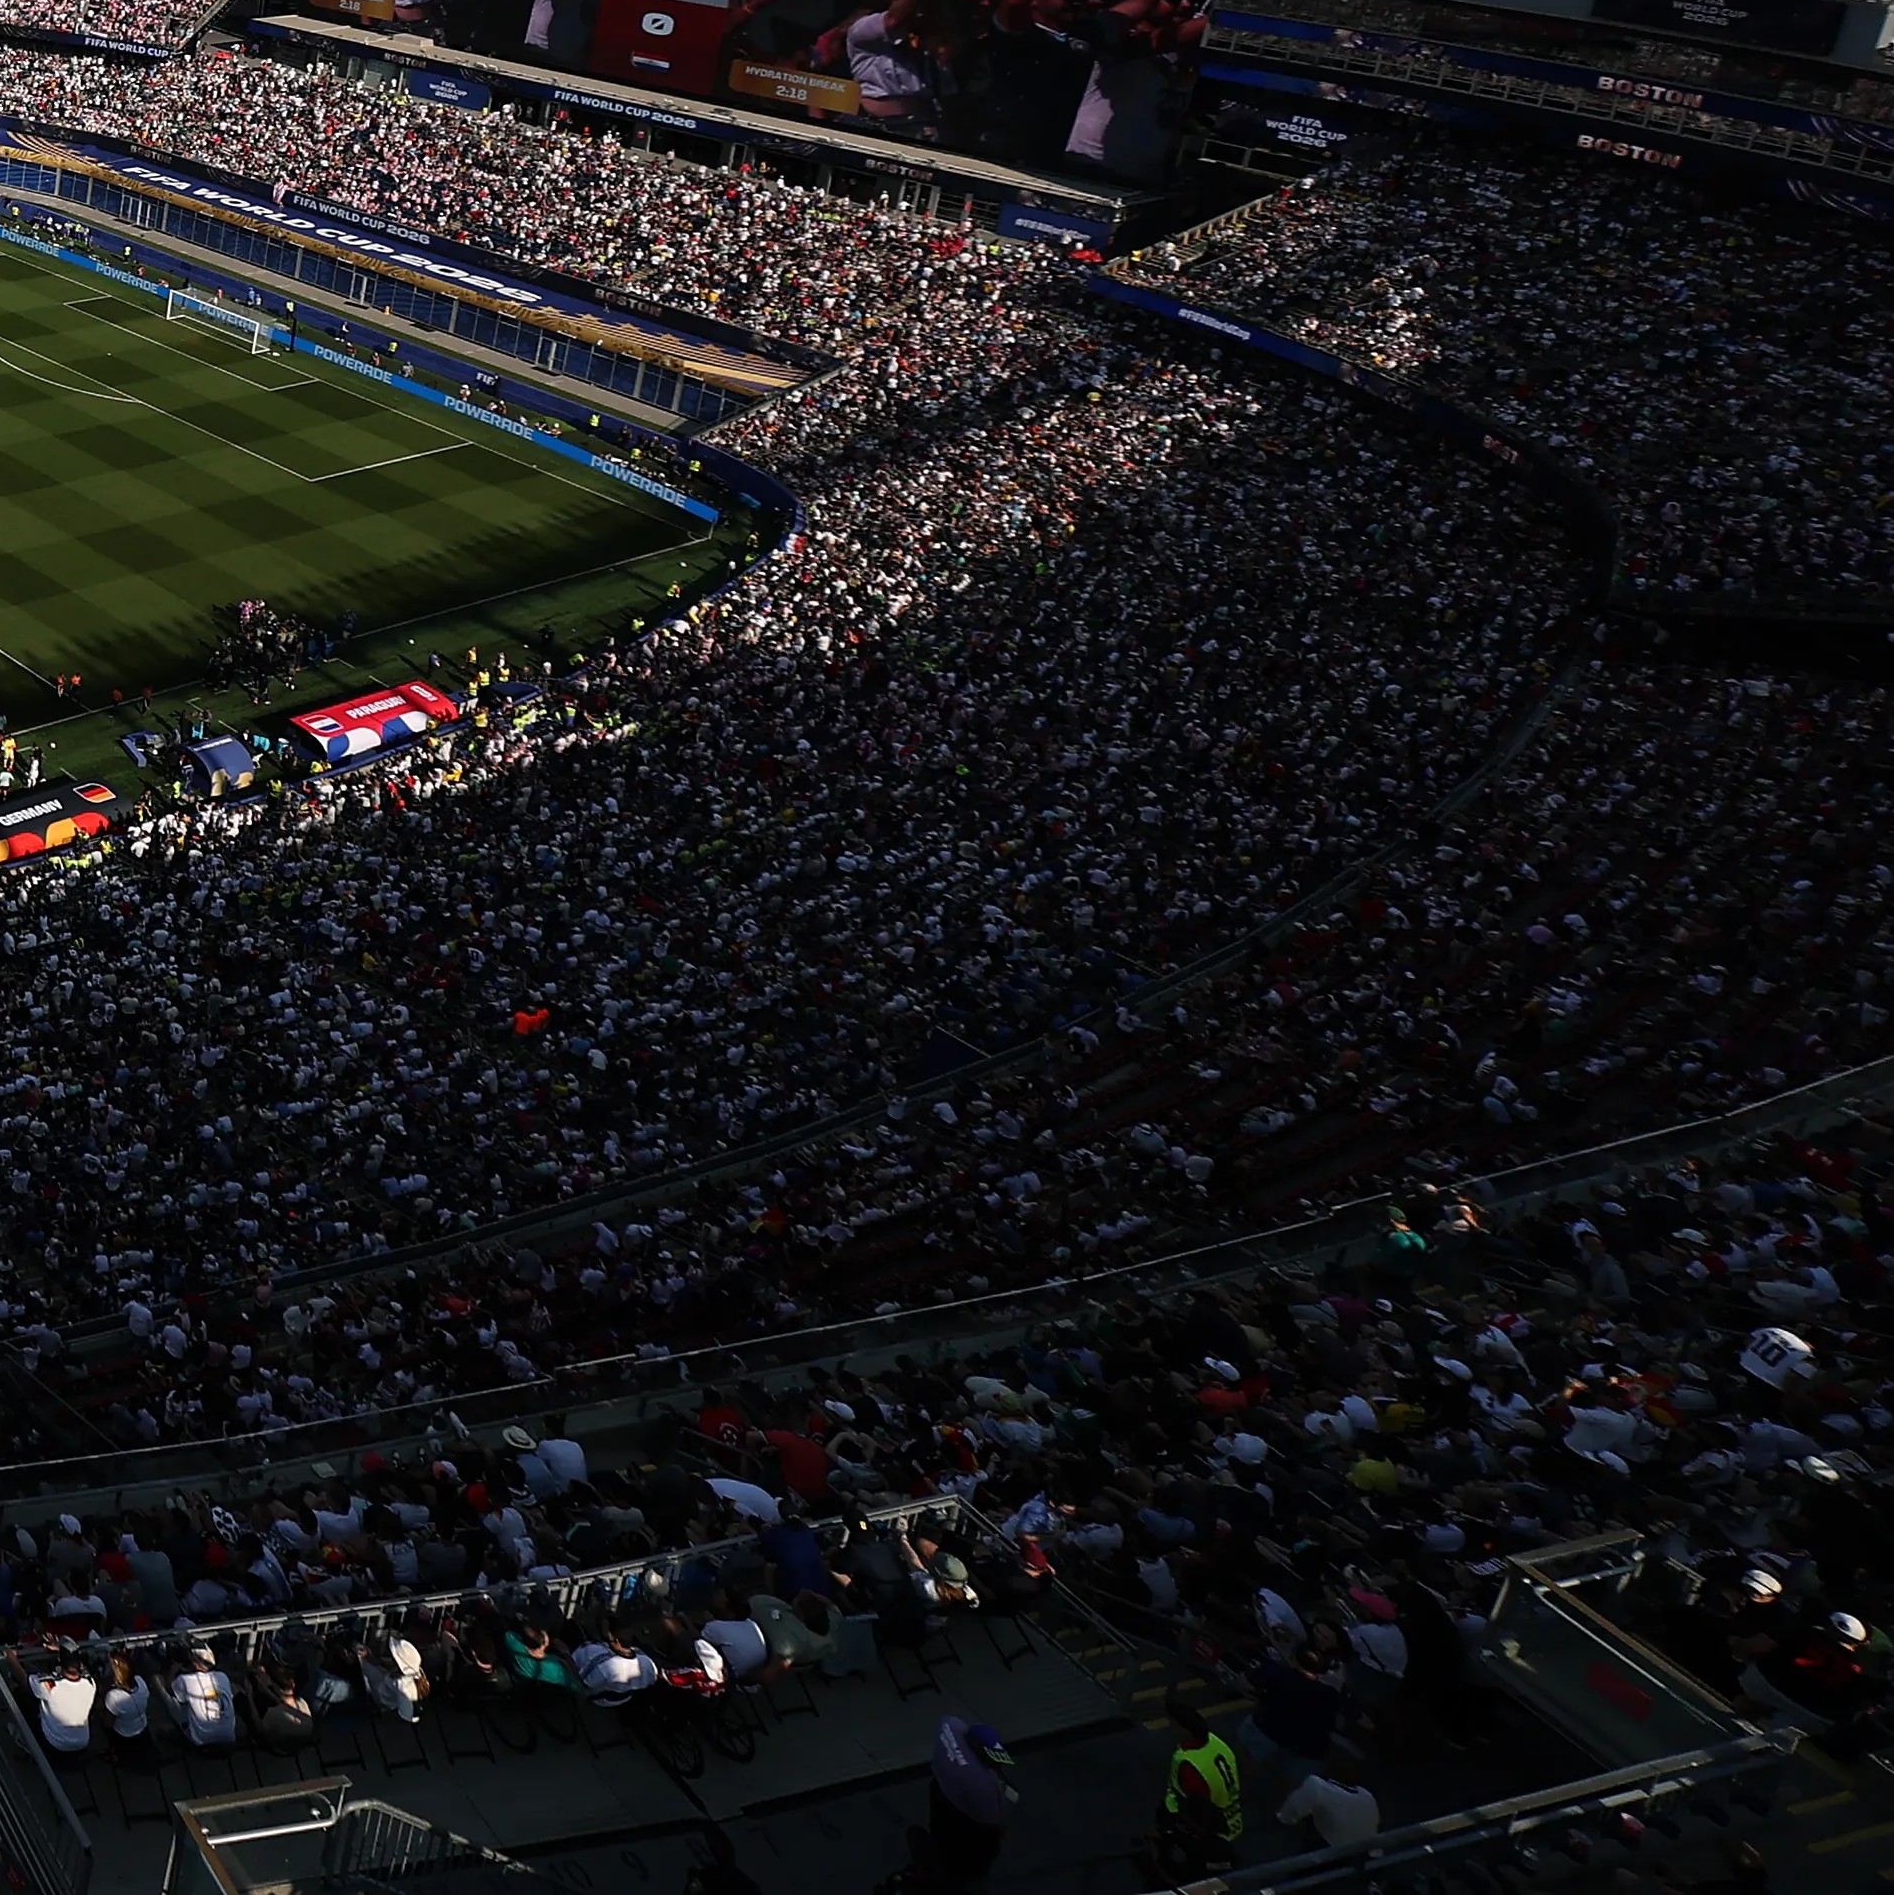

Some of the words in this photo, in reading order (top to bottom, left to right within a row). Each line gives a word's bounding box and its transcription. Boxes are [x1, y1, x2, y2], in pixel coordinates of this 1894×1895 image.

[339, 0, 360, 11] 2:18
[1673, 0, 1719, 16] WORLD
[1720, 7, 1750, 20] CUP
[641, 11, 675, 36] 0
[1682, 11, 1729, 26] 2026
[85, 37, 107, 50] FIFA
[109, 41, 145, 54] WORLD
[147, 46, 168, 57] CUP
[384, 52, 427, 68] BOSTON
[429, 83, 453, 94] WORLD
[452, 87, 467, 97] CUP
[441, 80, 456, 88] FIFA
[745, 65, 807, 85] HYDRATION
[809, 76, 846, 93] BREAK
[1597, 76, 1705, 107] BOSTON
[435, 90, 459, 102] 2026
[776, 85, 807, 101] 2:18
[554, 89, 583, 105] FIFA
[585, 96, 624, 113] WORLD
[625, 105, 652, 120] CUP
[652, 109, 696, 130] 2026
[1292, 115, 1322, 129] FIFA
[1266, 120, 1311, 138] WORLD
[1313, 128, 1348, 143] CUP
[1277, 133, 1327, 148] 2026
[1577, 134, 1683, 169] BOSTON
[864, 158, 936, 182] BOSTON
[293, 194, 317, 210] FIFA
[319, 201, 359, 224] WORLD
[360, 213, 387, 232] CUP
[386, 223, 431, 246] 2026
[1, 227, 60, 257] POWERADE
[121, 164, 191, 191] FIFA
[192, 186, 316, 230] WORLD
[316, 228, 394, 254] CUP
[389, 252, 543, 303] 2026
[95, 263, 159, 294] POWERADE
[595, 287, 663, 318] BOSTON
[313, 345, 393, 385] POWERADE
[444, 395, 535, 441] POWERADE
[591, 455, 687, 506] POWERADE
[348, 694, 407, 720] PARAGUAY
[1755, 1333, 1788, 1368] 10
